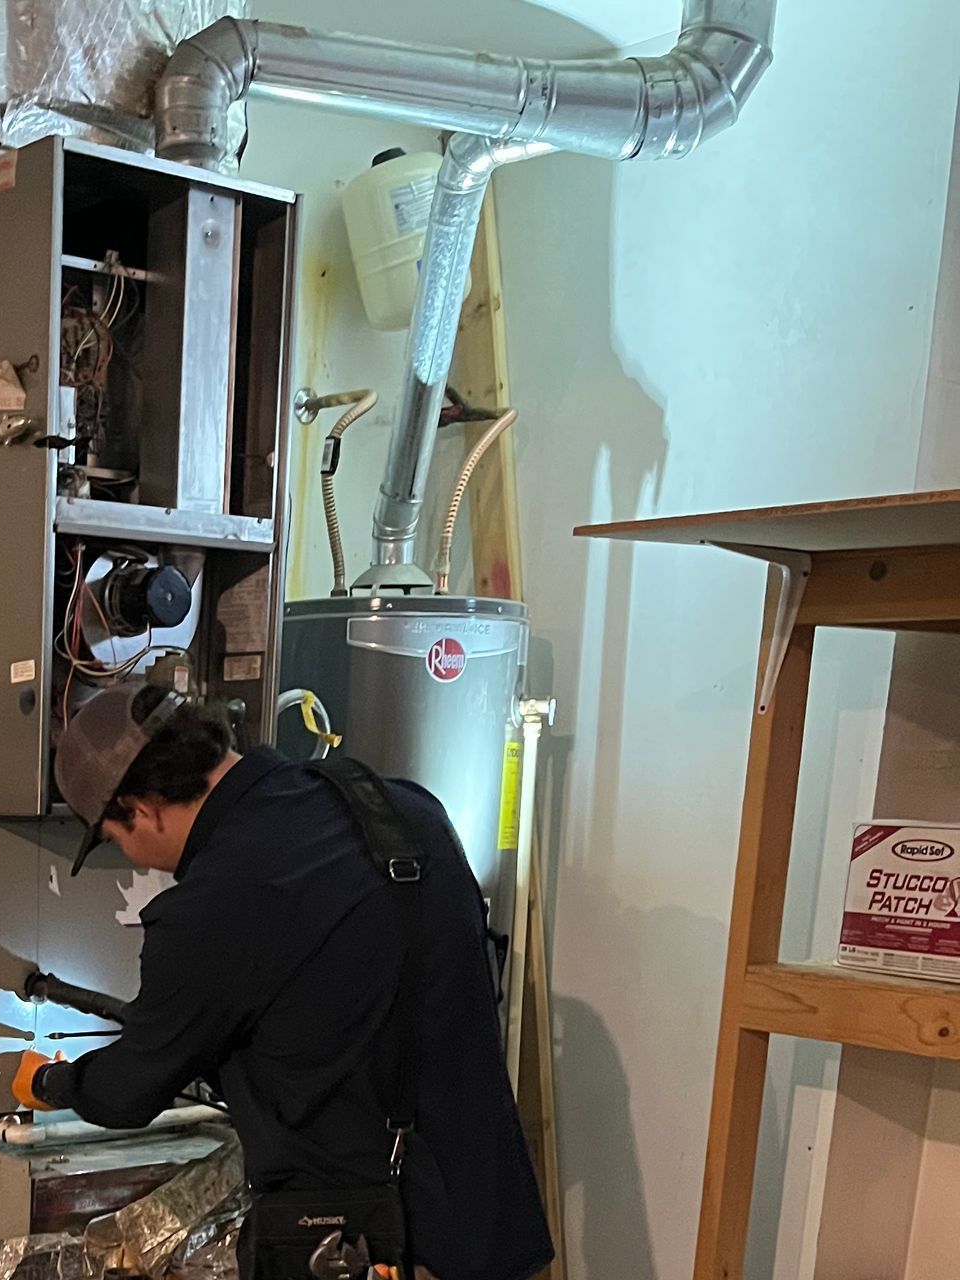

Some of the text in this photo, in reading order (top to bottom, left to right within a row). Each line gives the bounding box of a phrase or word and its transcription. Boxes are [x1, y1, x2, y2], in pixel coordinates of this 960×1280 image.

[431, 638, 466, 675] Rheem
[900, 844, 945, 857] Rapid Set
[866, 868, 949, 893] STUCCO
[868, 891, 933, 916] PATCH
